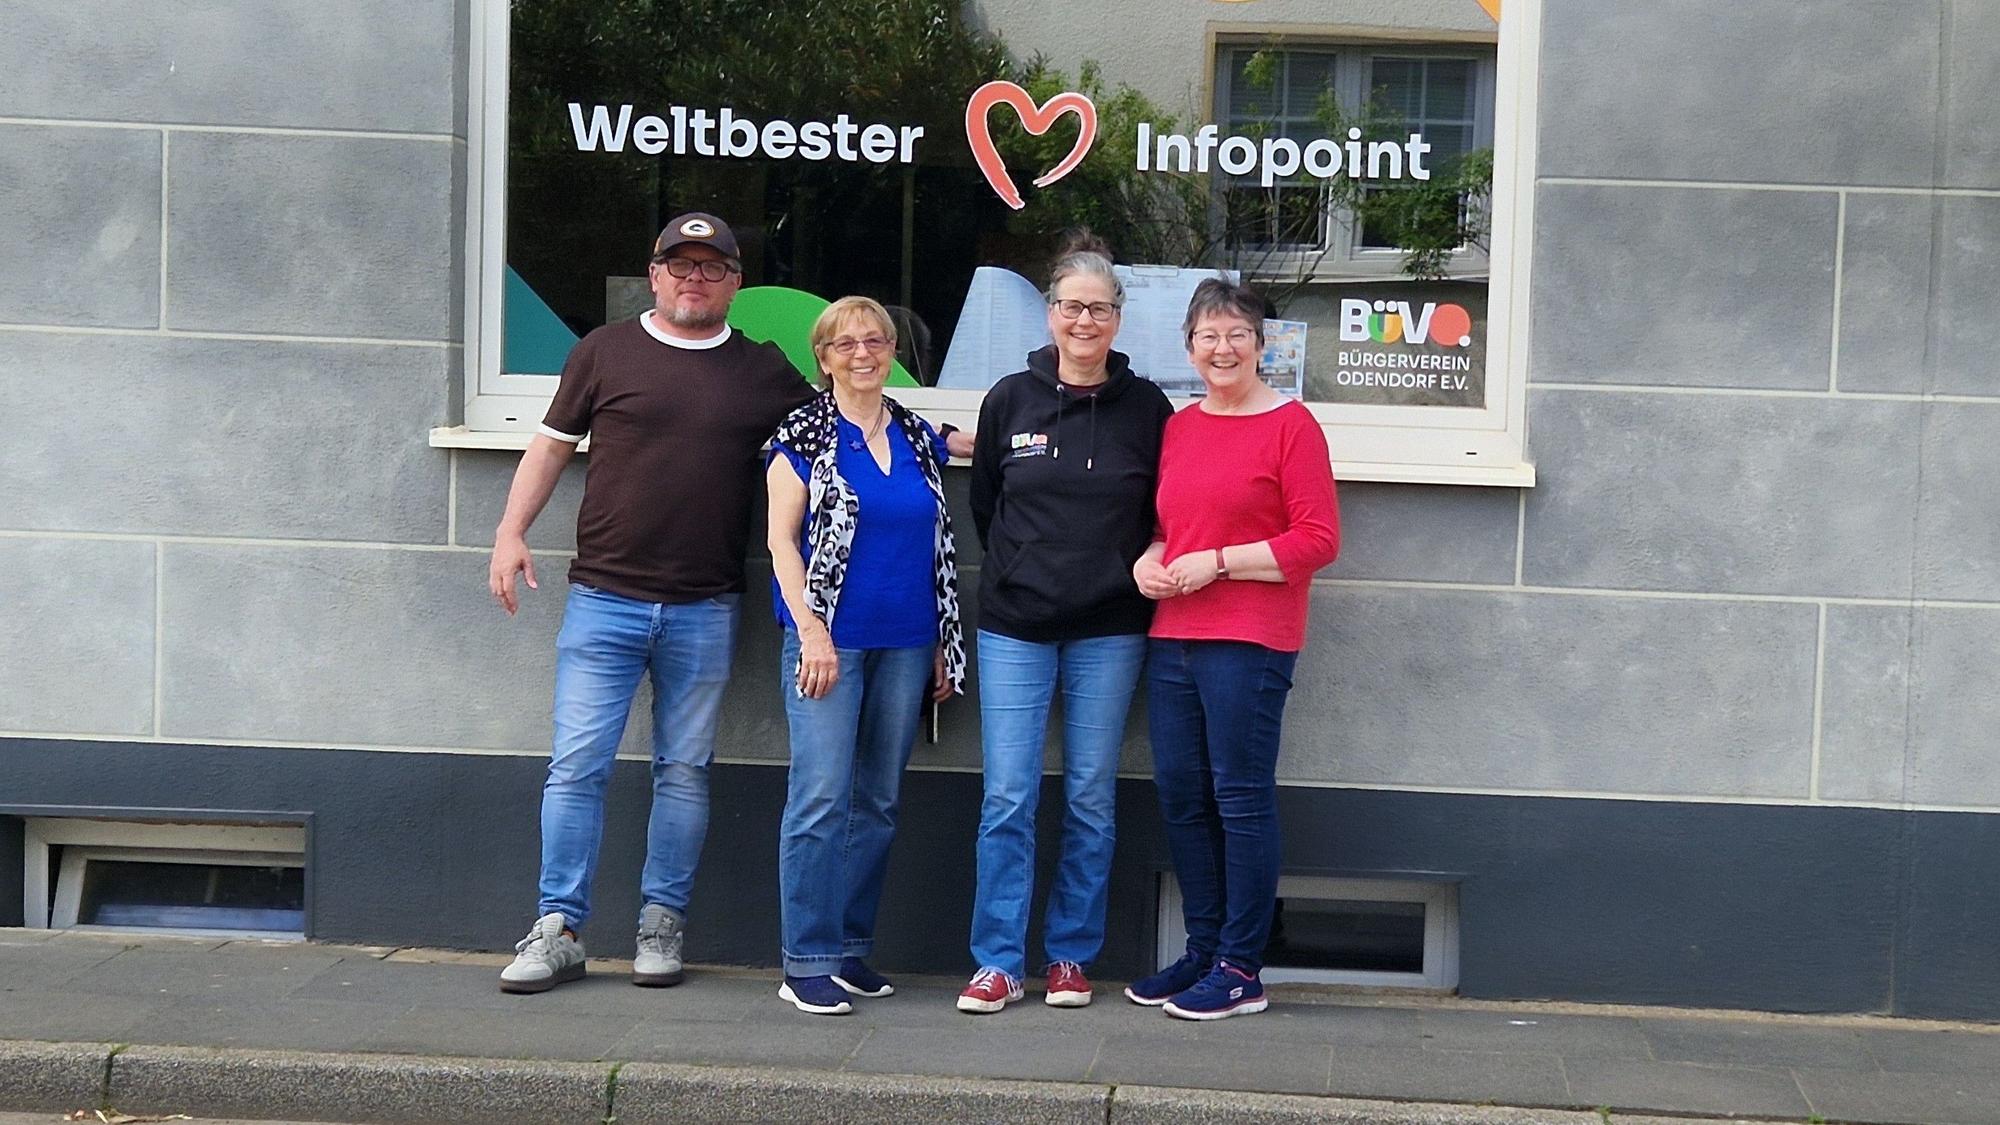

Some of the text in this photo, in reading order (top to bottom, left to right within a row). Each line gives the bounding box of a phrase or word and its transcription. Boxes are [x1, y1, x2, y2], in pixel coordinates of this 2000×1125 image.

[568, 103, 924, 163] Weltbester
[1137, 123, 1431, 187] Infopoint
[1337, 371, 1469, 390] ODENDORF E.V.
[1338, 349, 1470, 371] BÜRGERVEREIN
